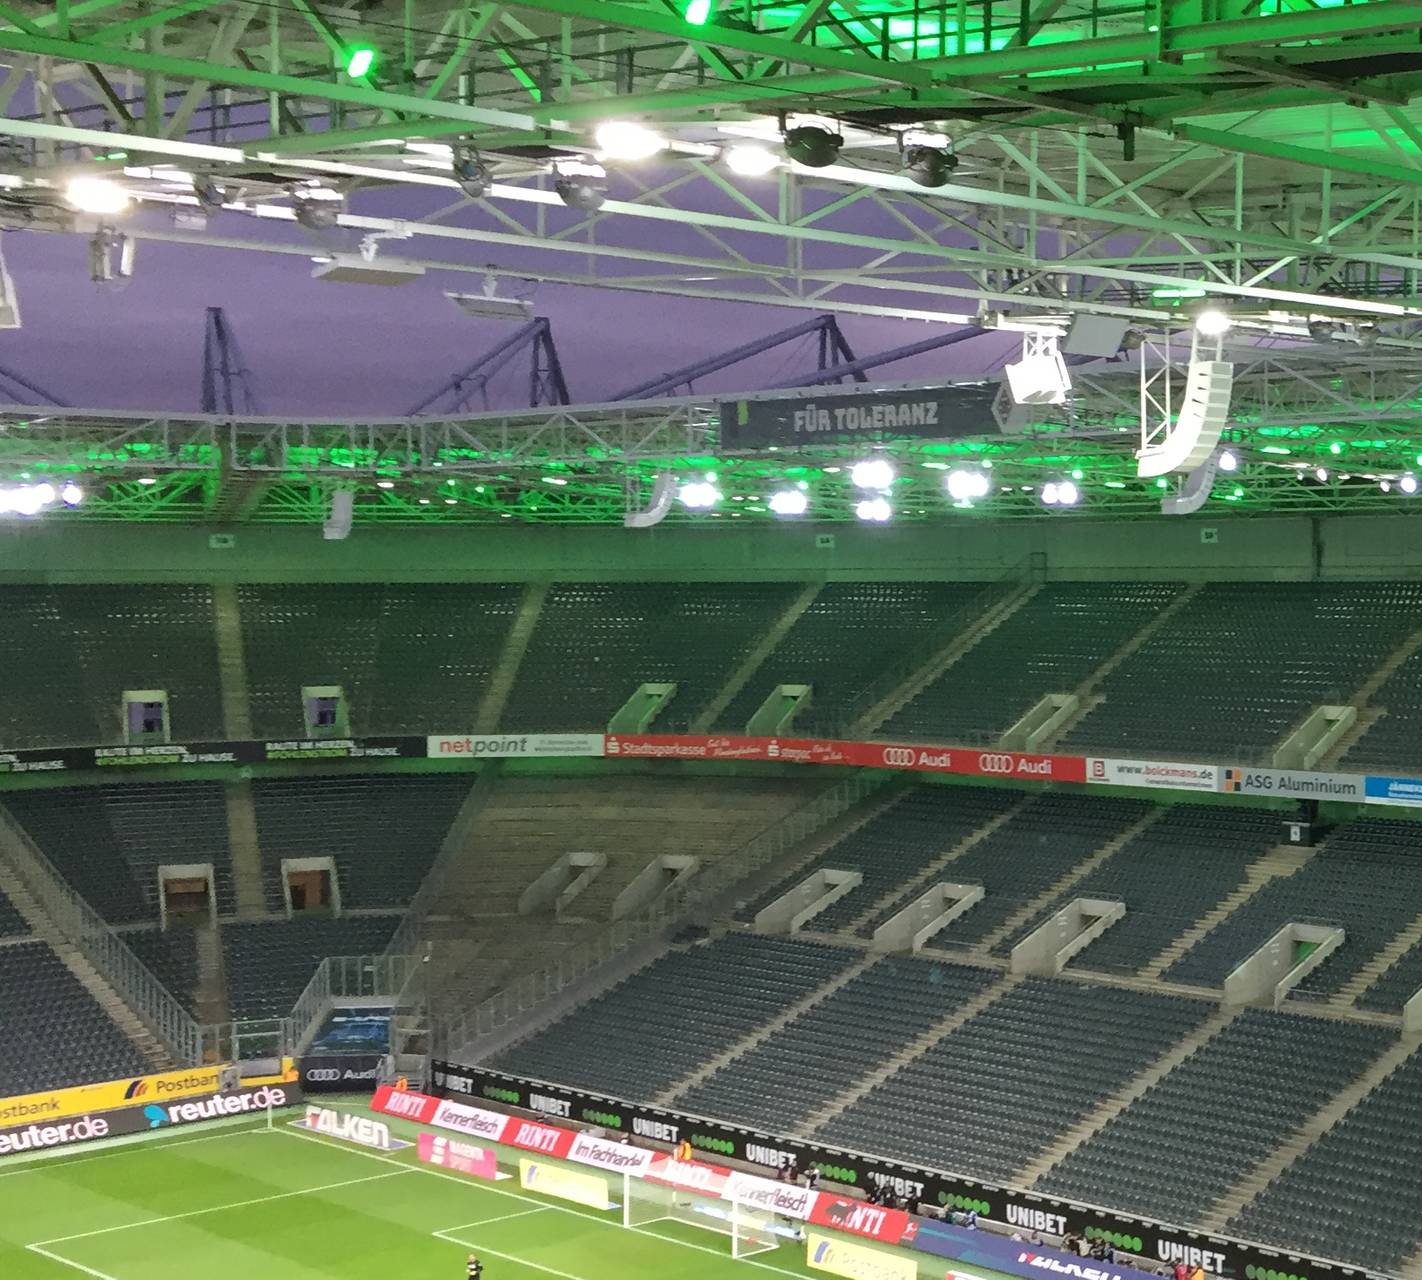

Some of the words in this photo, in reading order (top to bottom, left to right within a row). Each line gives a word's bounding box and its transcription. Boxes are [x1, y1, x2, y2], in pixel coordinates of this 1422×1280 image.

[794, 404, 831, 432] FÜR
[835, 402, 939, 431] TOLERANZ
[440, 737, 528, 755] netpoint
[622, 742, 706, 757] Stadtsparkasse
[918, 752, 951, 767] Audi
[1017, 758, 1052, 774] Audi
[1245, 774, 1273, 789] ASG
[1278, 776, 1356, 795] Aluminium
[156, 1074, 219, 1093] Postban
[0, 1098, 60, 1119] stbank
[168, 1086, 286, 1122] reuter.de
[529, 1093, 572, 1117] UNIBET
[0, 1116, 109, 1152] euter.de
[305, 1105, 389, 1148] FALKEN
[440, 1107, 498, 1135] Kennerfleisch
[632, 1117, 679, 1142] UNIBET
[513, 1123, 561, 1152] RINTI
[575, 1141, 589, 1157] Im
[588, 1144, 646, 1167] Fachhandel
[746, 1143, 797, 1169] UNIBET
[1006, 1203, 1067, 1236] UNIBET
[1158, 1239, 1226, 1274] UNIBET
